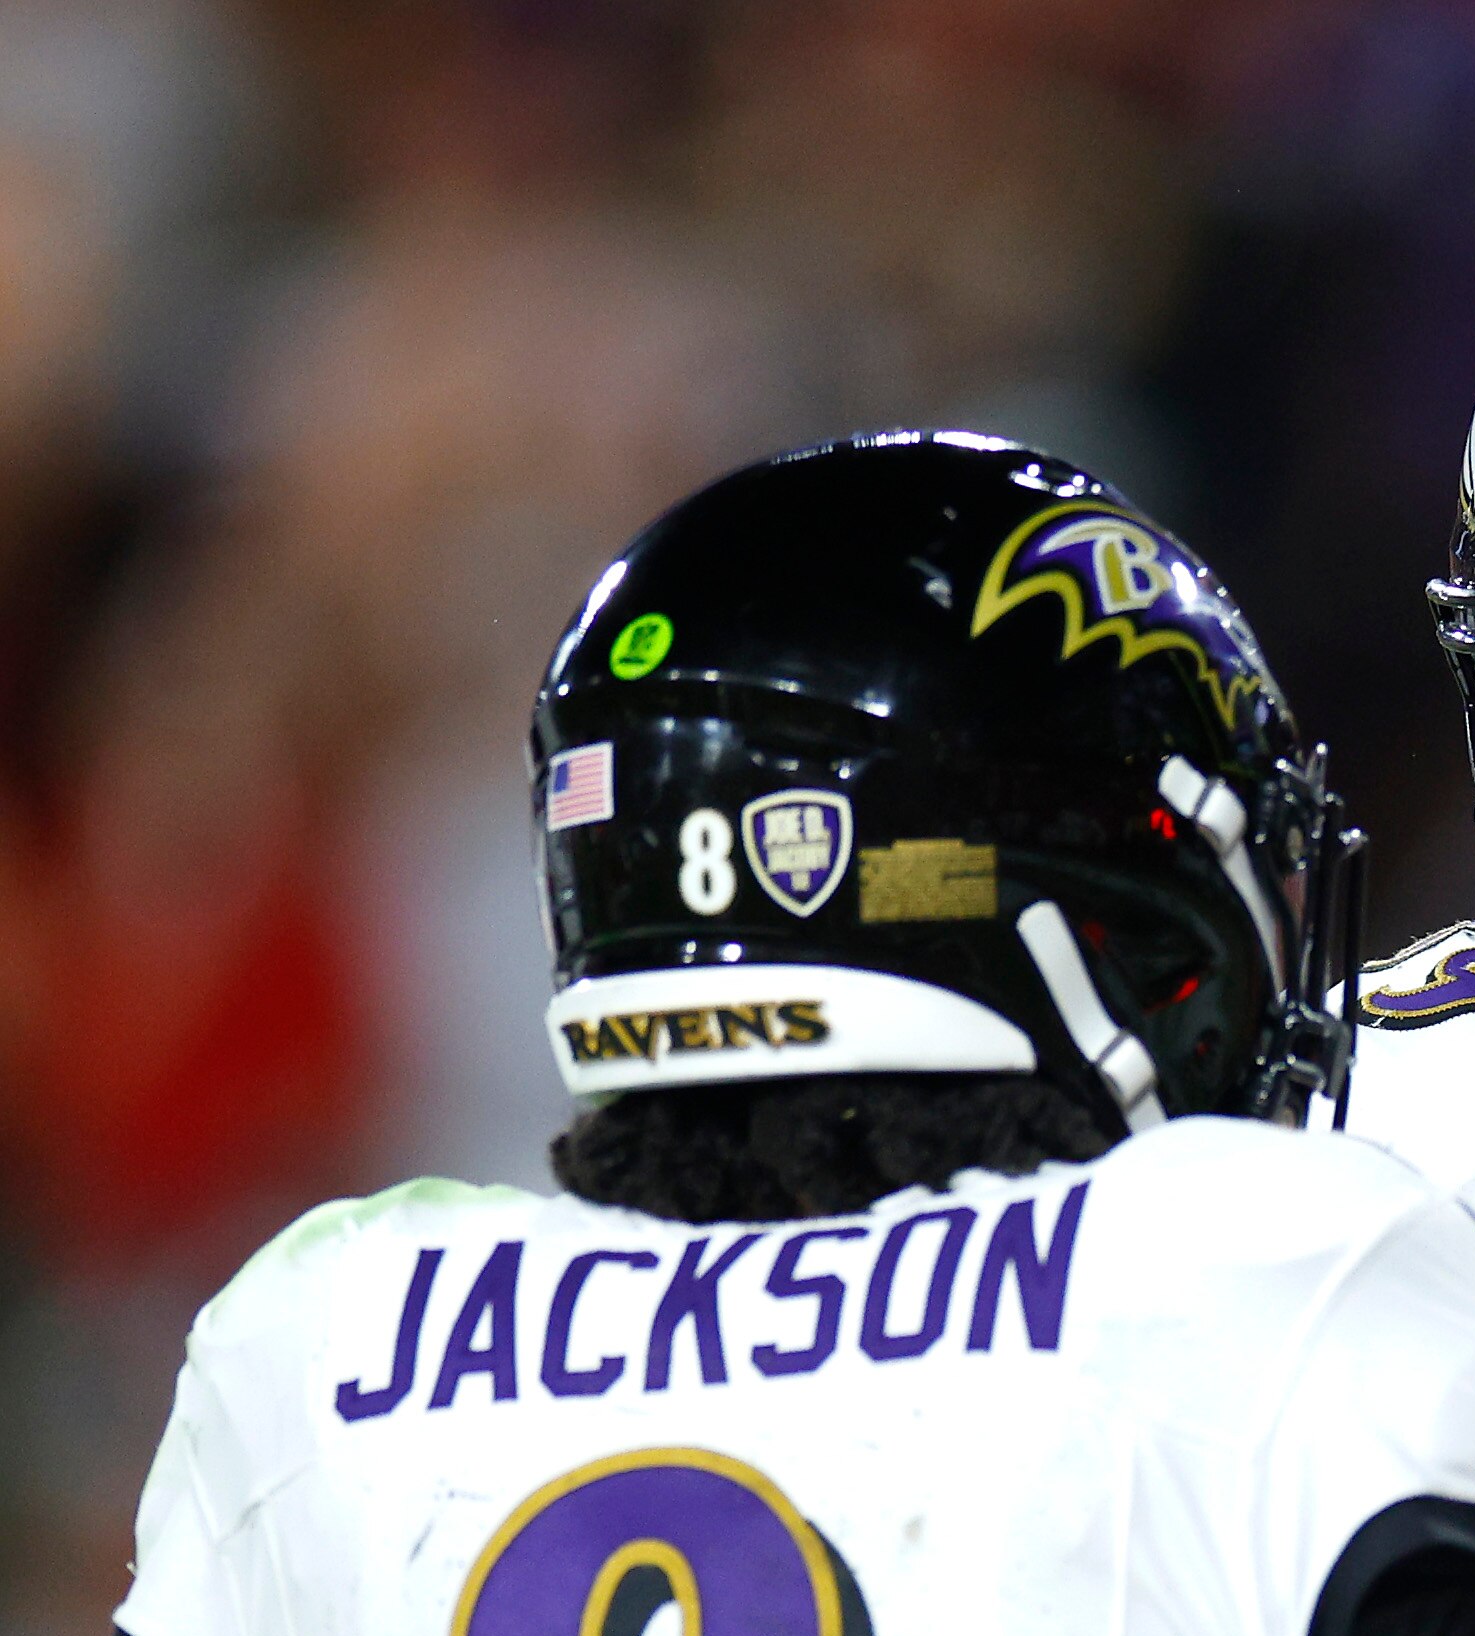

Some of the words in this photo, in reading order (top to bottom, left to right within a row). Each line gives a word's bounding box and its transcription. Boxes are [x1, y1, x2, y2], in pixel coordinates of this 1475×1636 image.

[679, 807, 737, 917] 8
[560, 998, 830, 1066] RAVENS
[335, 1179, 1091, 1422] JACKSON
